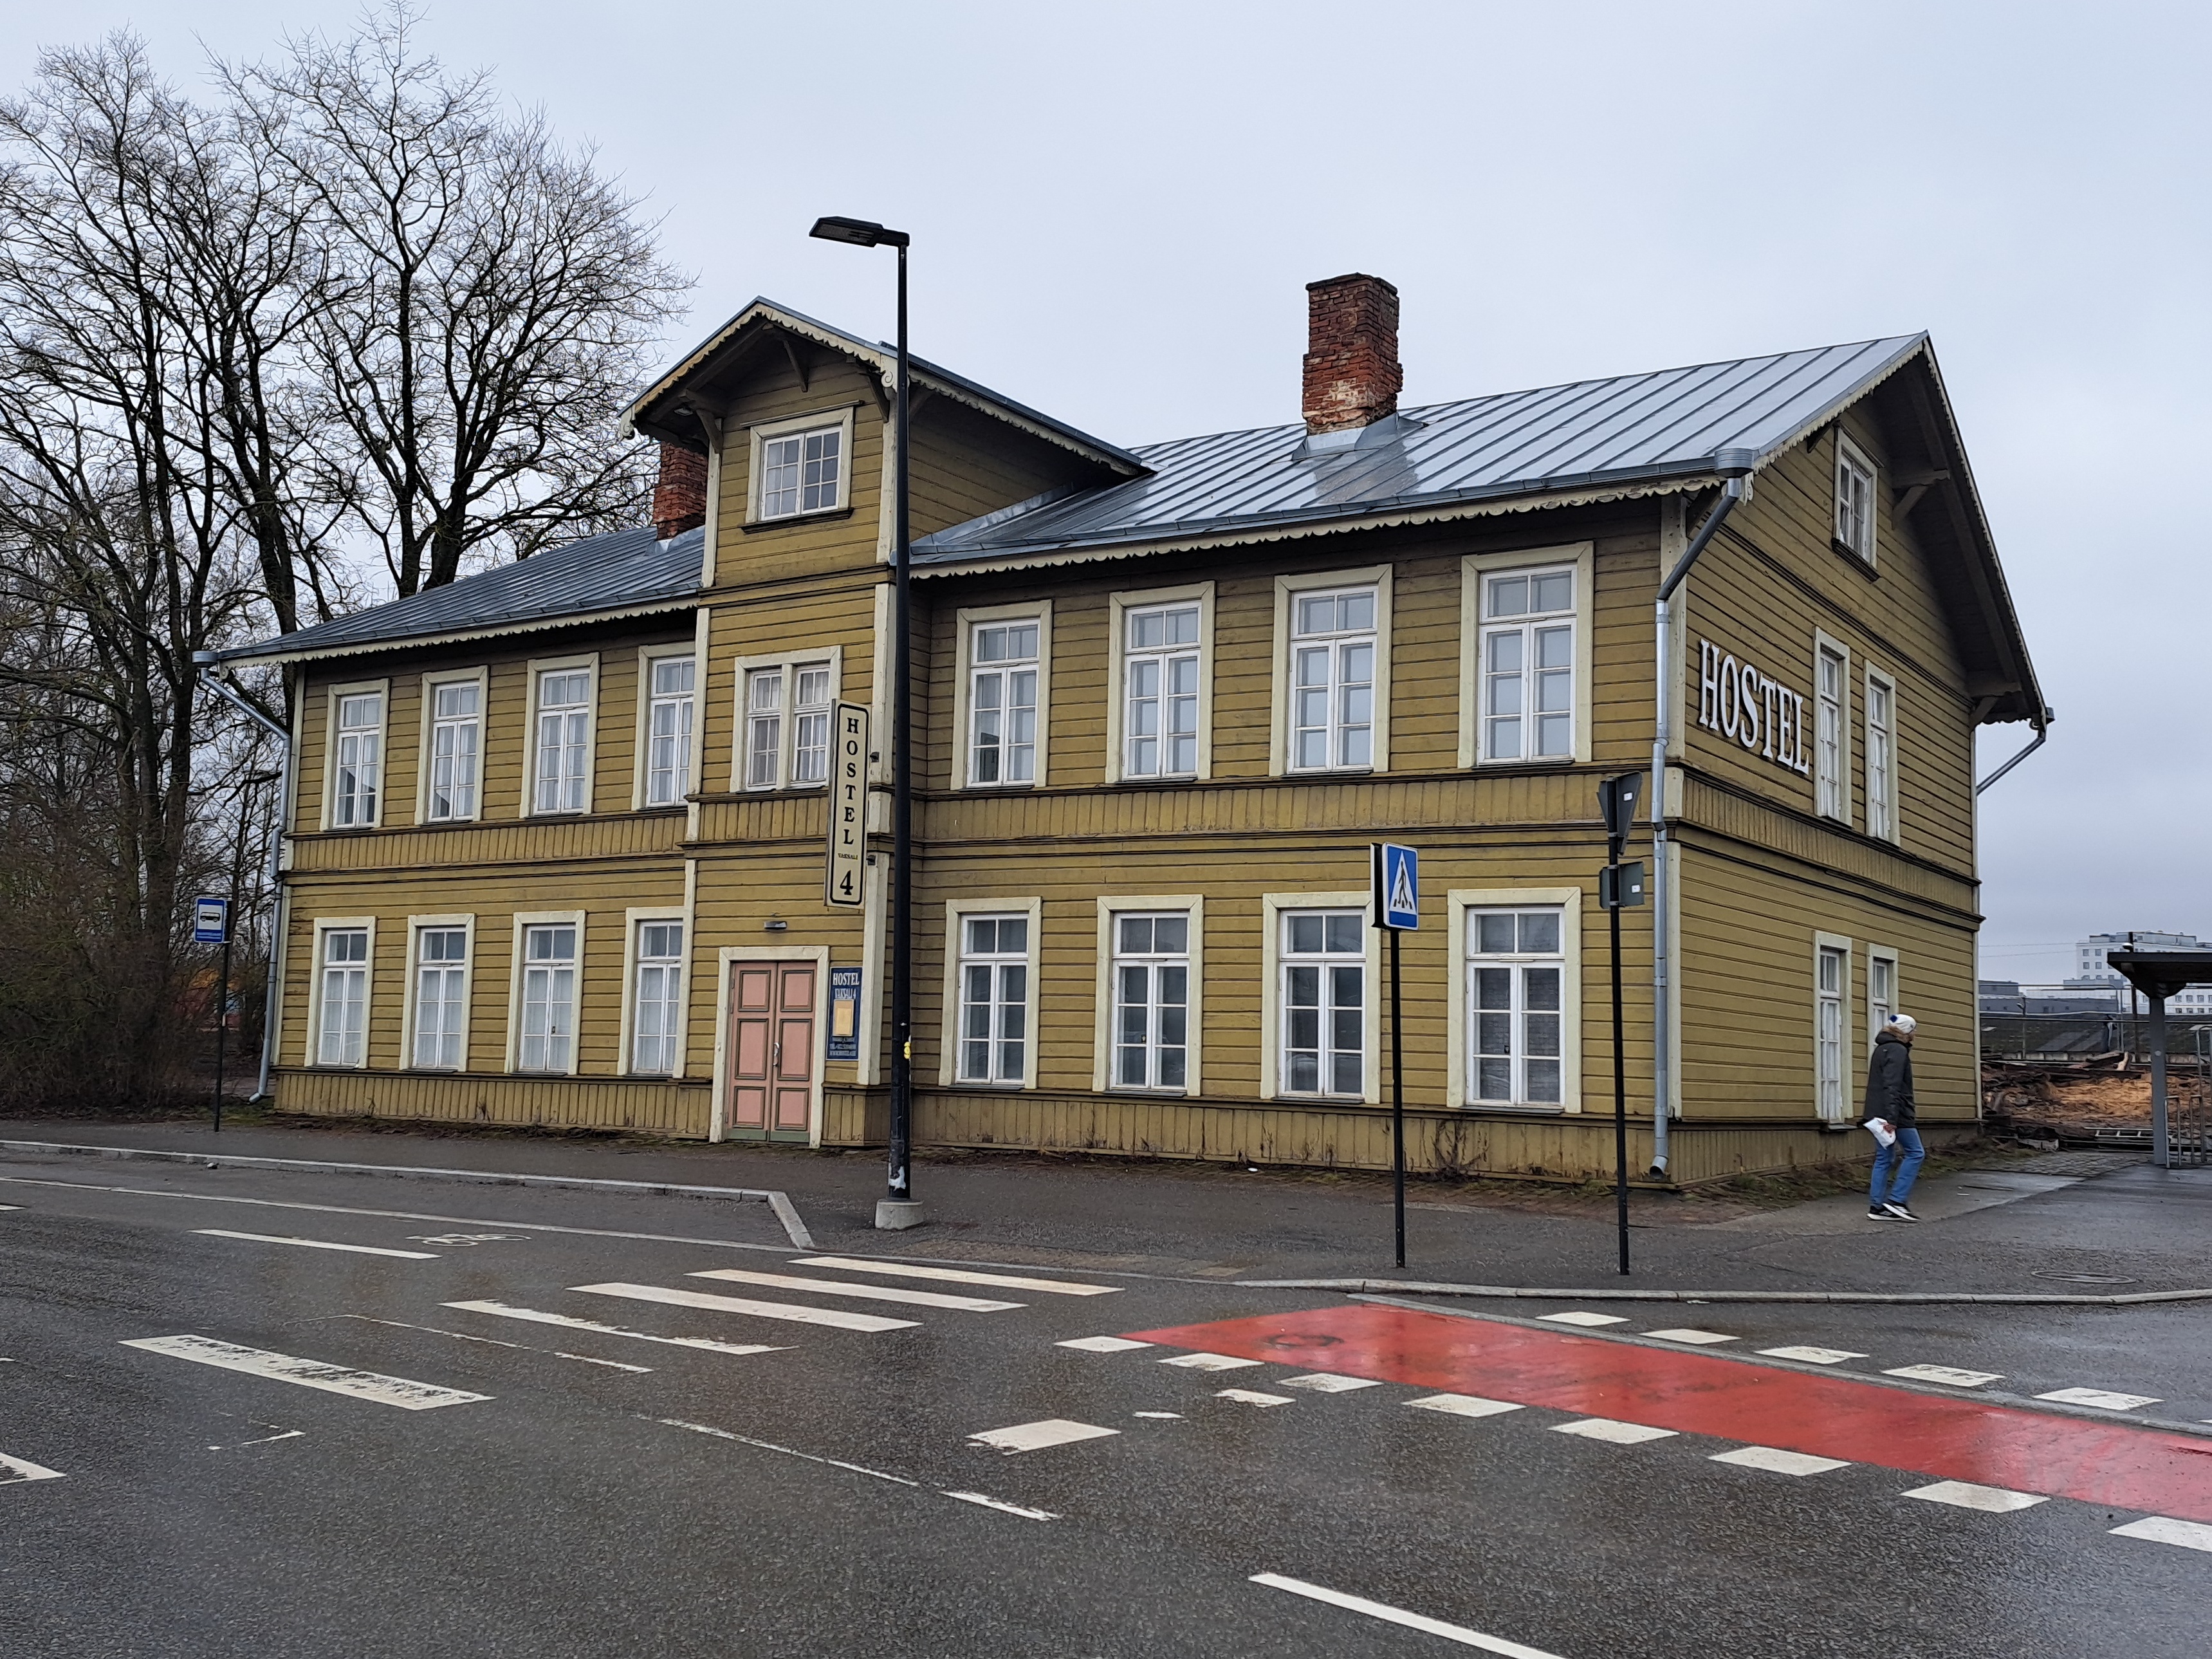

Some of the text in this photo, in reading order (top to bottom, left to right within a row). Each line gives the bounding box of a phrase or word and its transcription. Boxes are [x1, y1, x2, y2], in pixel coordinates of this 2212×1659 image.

[1699, 638, 1809, 775] HOSTEL
[843, 718, 860, 845] HOSTEL
[840, 870, 854, 895] 4
[833, 972, 860, 985] HOSTEL
